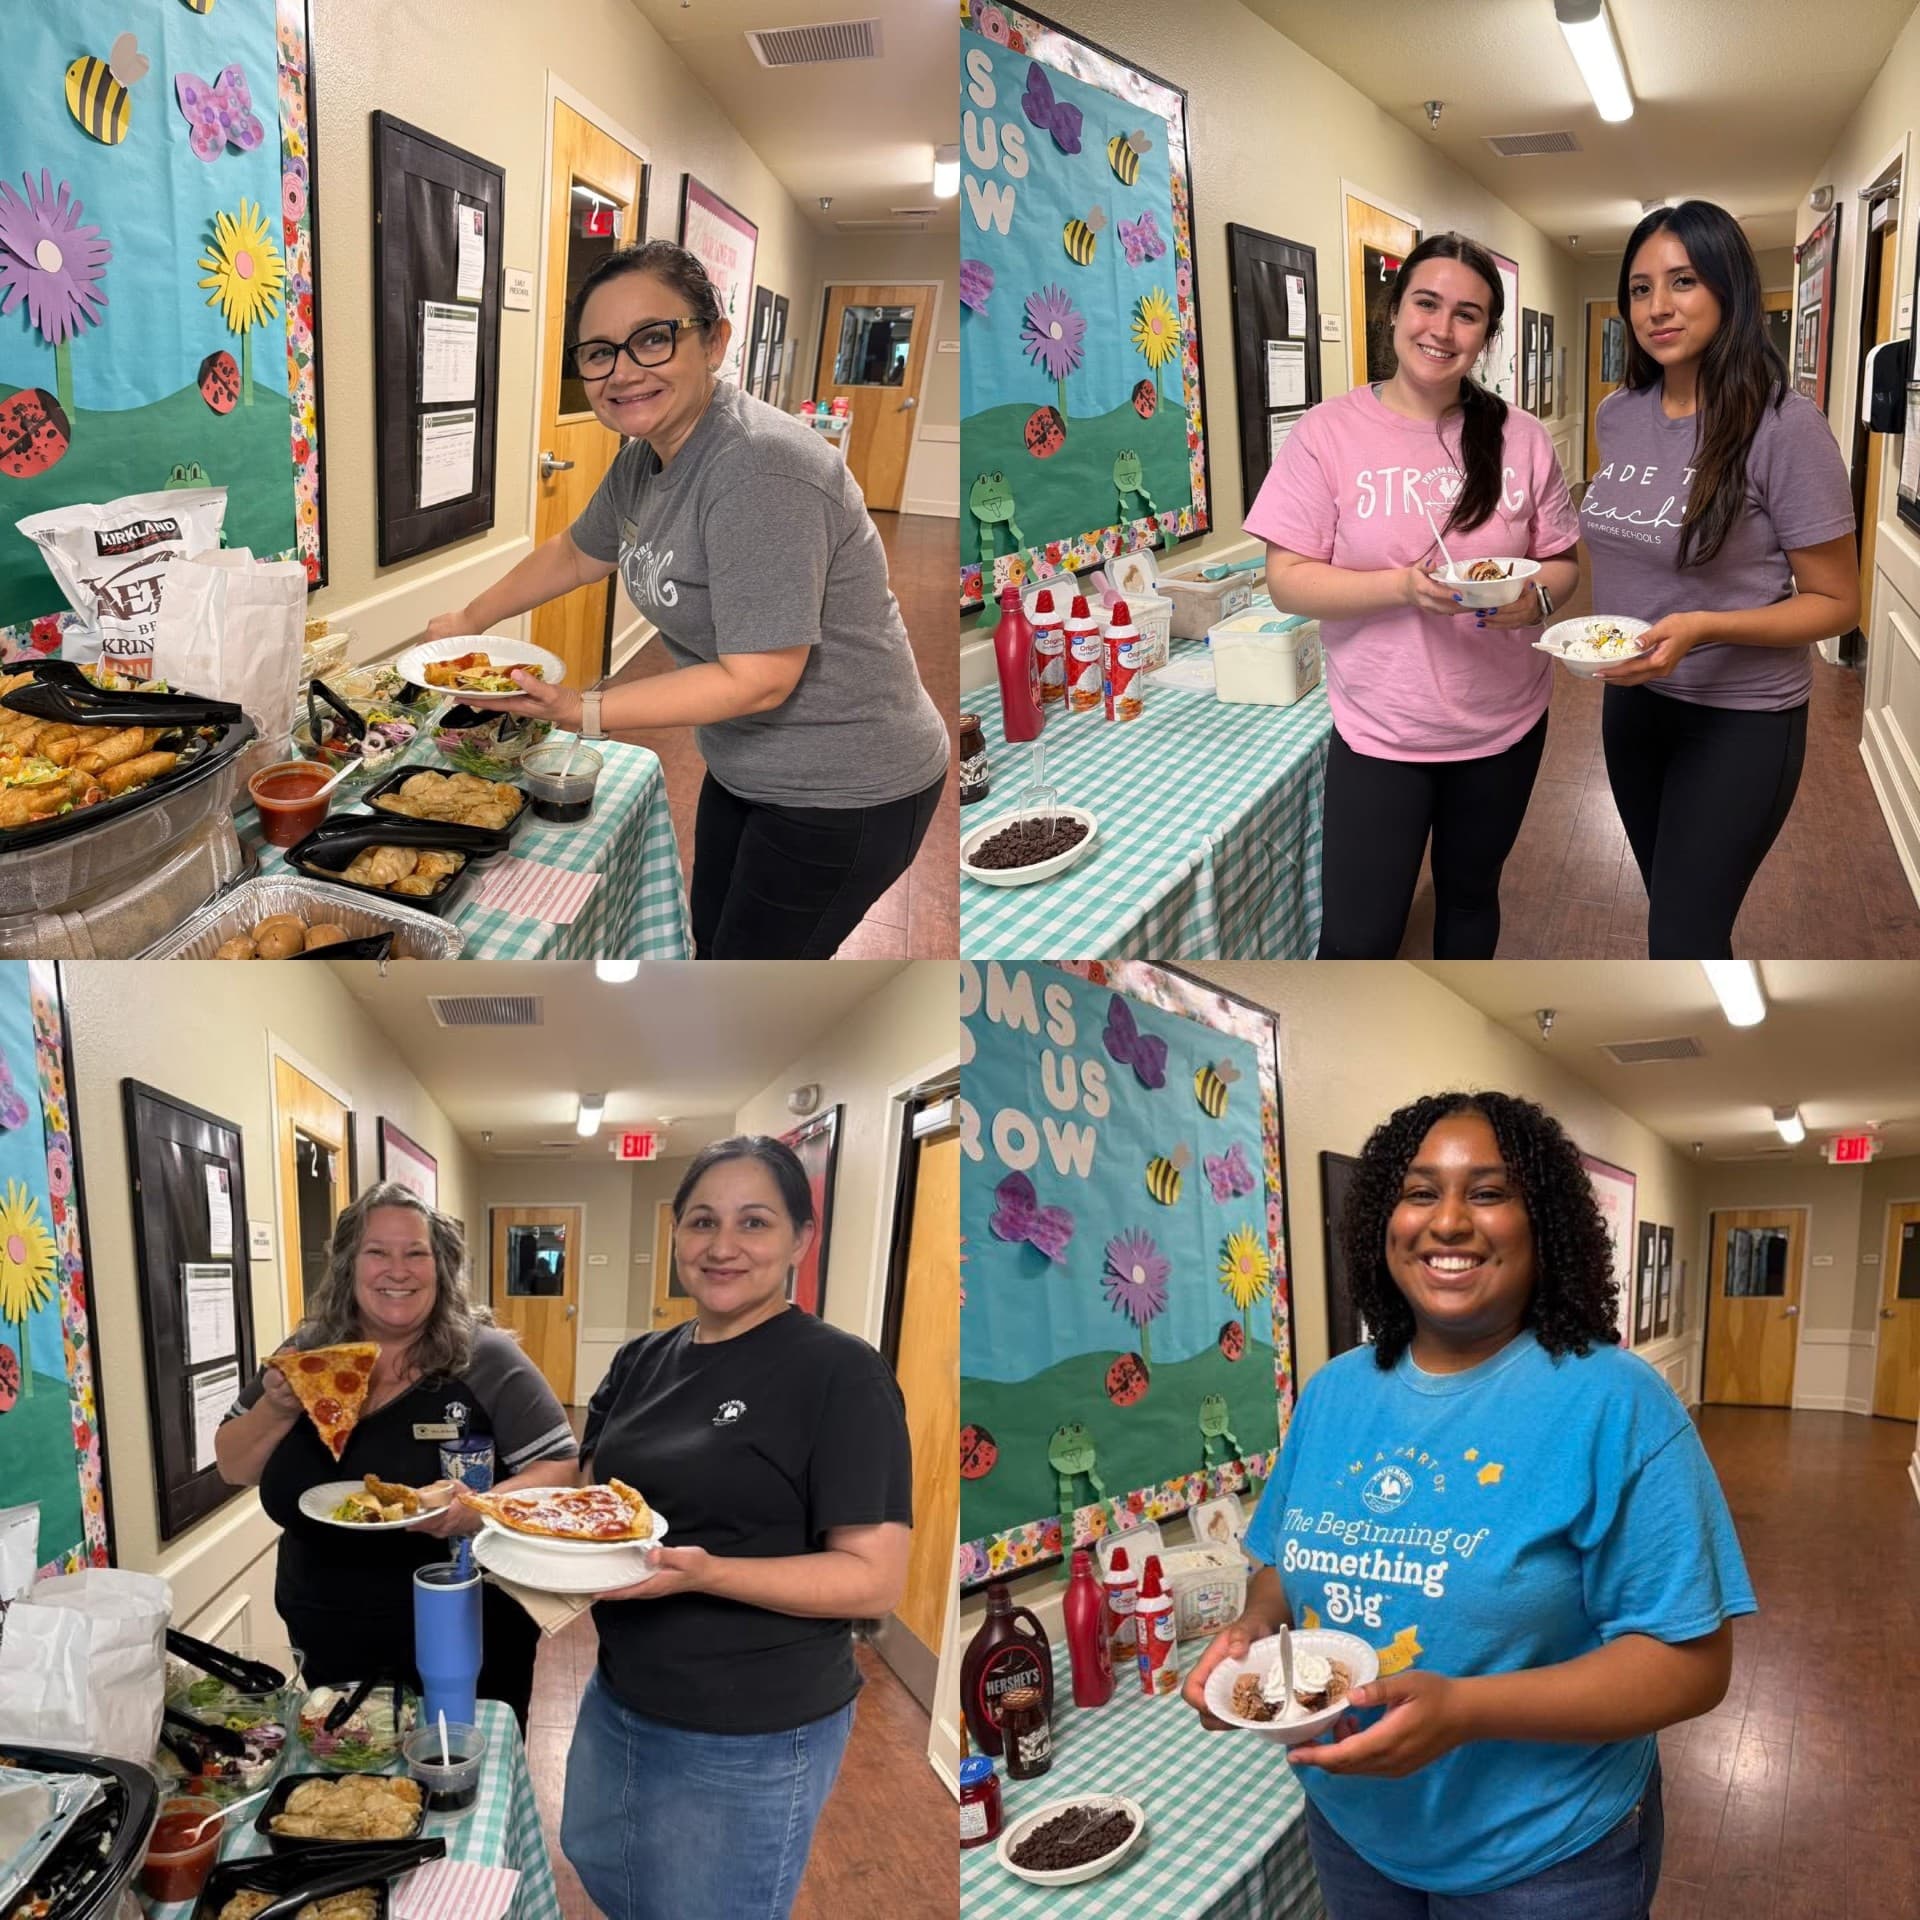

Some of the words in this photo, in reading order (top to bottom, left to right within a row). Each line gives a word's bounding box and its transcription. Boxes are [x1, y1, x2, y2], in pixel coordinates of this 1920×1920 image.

[963, 110, 1030, 179] US
[1380, 255, 1387, 282] 2
[1593, 461, 1658, 485] ADE
[99, 520, 177, 546] KIRKLAND
[1622, 528, 1661, 544] SCHOOLS
[102, 637, 155, 656] KRIN
[960, 960, 1076, 1047] OMS
[1041, 1049, 1111, 1118] US
[623, 1135, 652, 1158] EXIT
[960, 1098, 1097, 1178] ROW
[1836, 1137, 1868, 1161] EXIT
[310, 1142, 319, 1178] 2
[1283, 1508, 1313, 1533] The
[1314, 1511, 1452, 1556] Beginning
[1452, 1527, 1490, 1559] of
[1283, 1538, 1449, 1598] Something
[1323, 1581, 1384, 1628] Big
[986, 1667, 1041, 1697] HERSHEY'S
